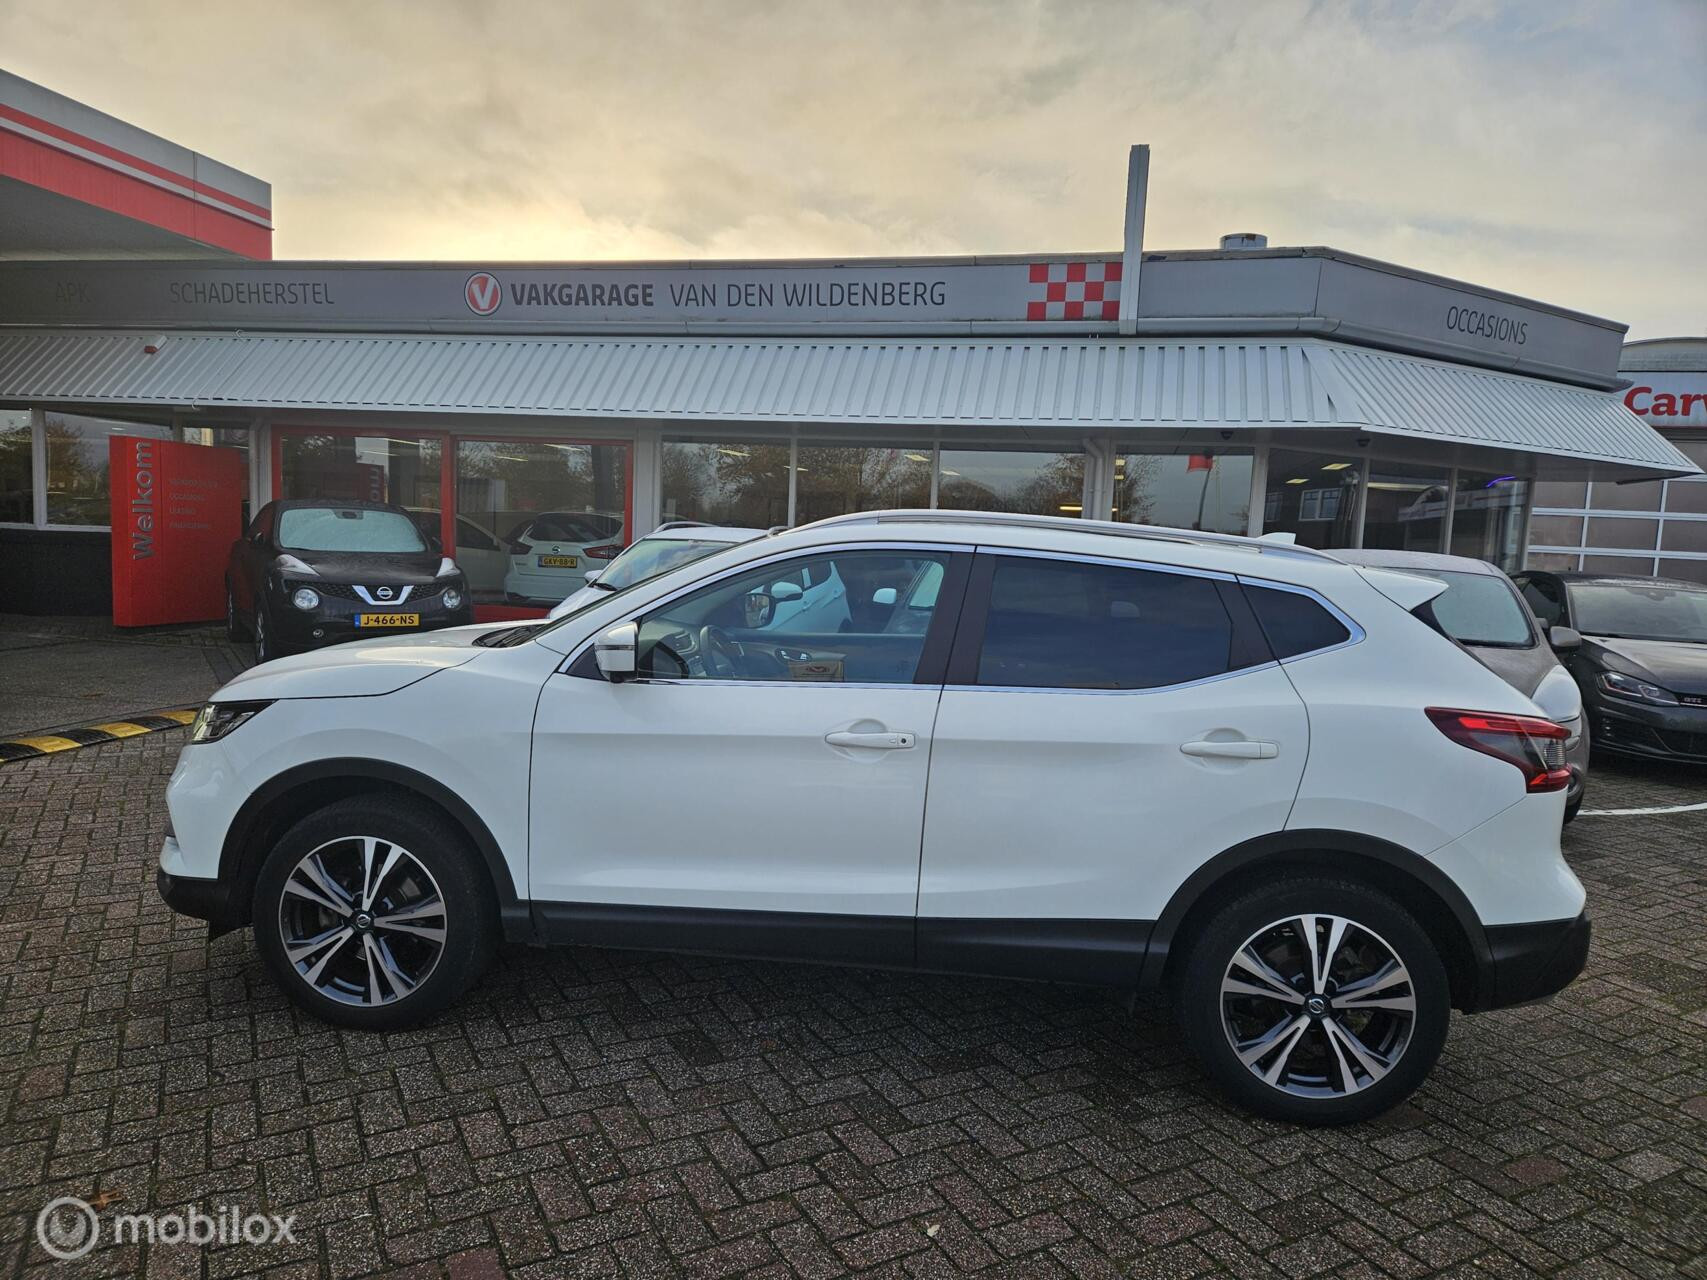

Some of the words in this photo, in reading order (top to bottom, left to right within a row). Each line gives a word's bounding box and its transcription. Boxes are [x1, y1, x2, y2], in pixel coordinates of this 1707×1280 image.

[55, 282, 91, 304] APK
[169, 282, 335, 305] SCHADEHERSTEL
[511, 283, 654, 307] VAKGARAGE
[670, 283, 717, 308] VAN
[727, 283, 775, 307] DEN
[783, 281, 946, 307] WILDENBERG
[1447, 305, 1528, 346] OCCASIONS
[132, 439, 155, 561] Welkom
[363, 615, 415, 625] J-466-NS
